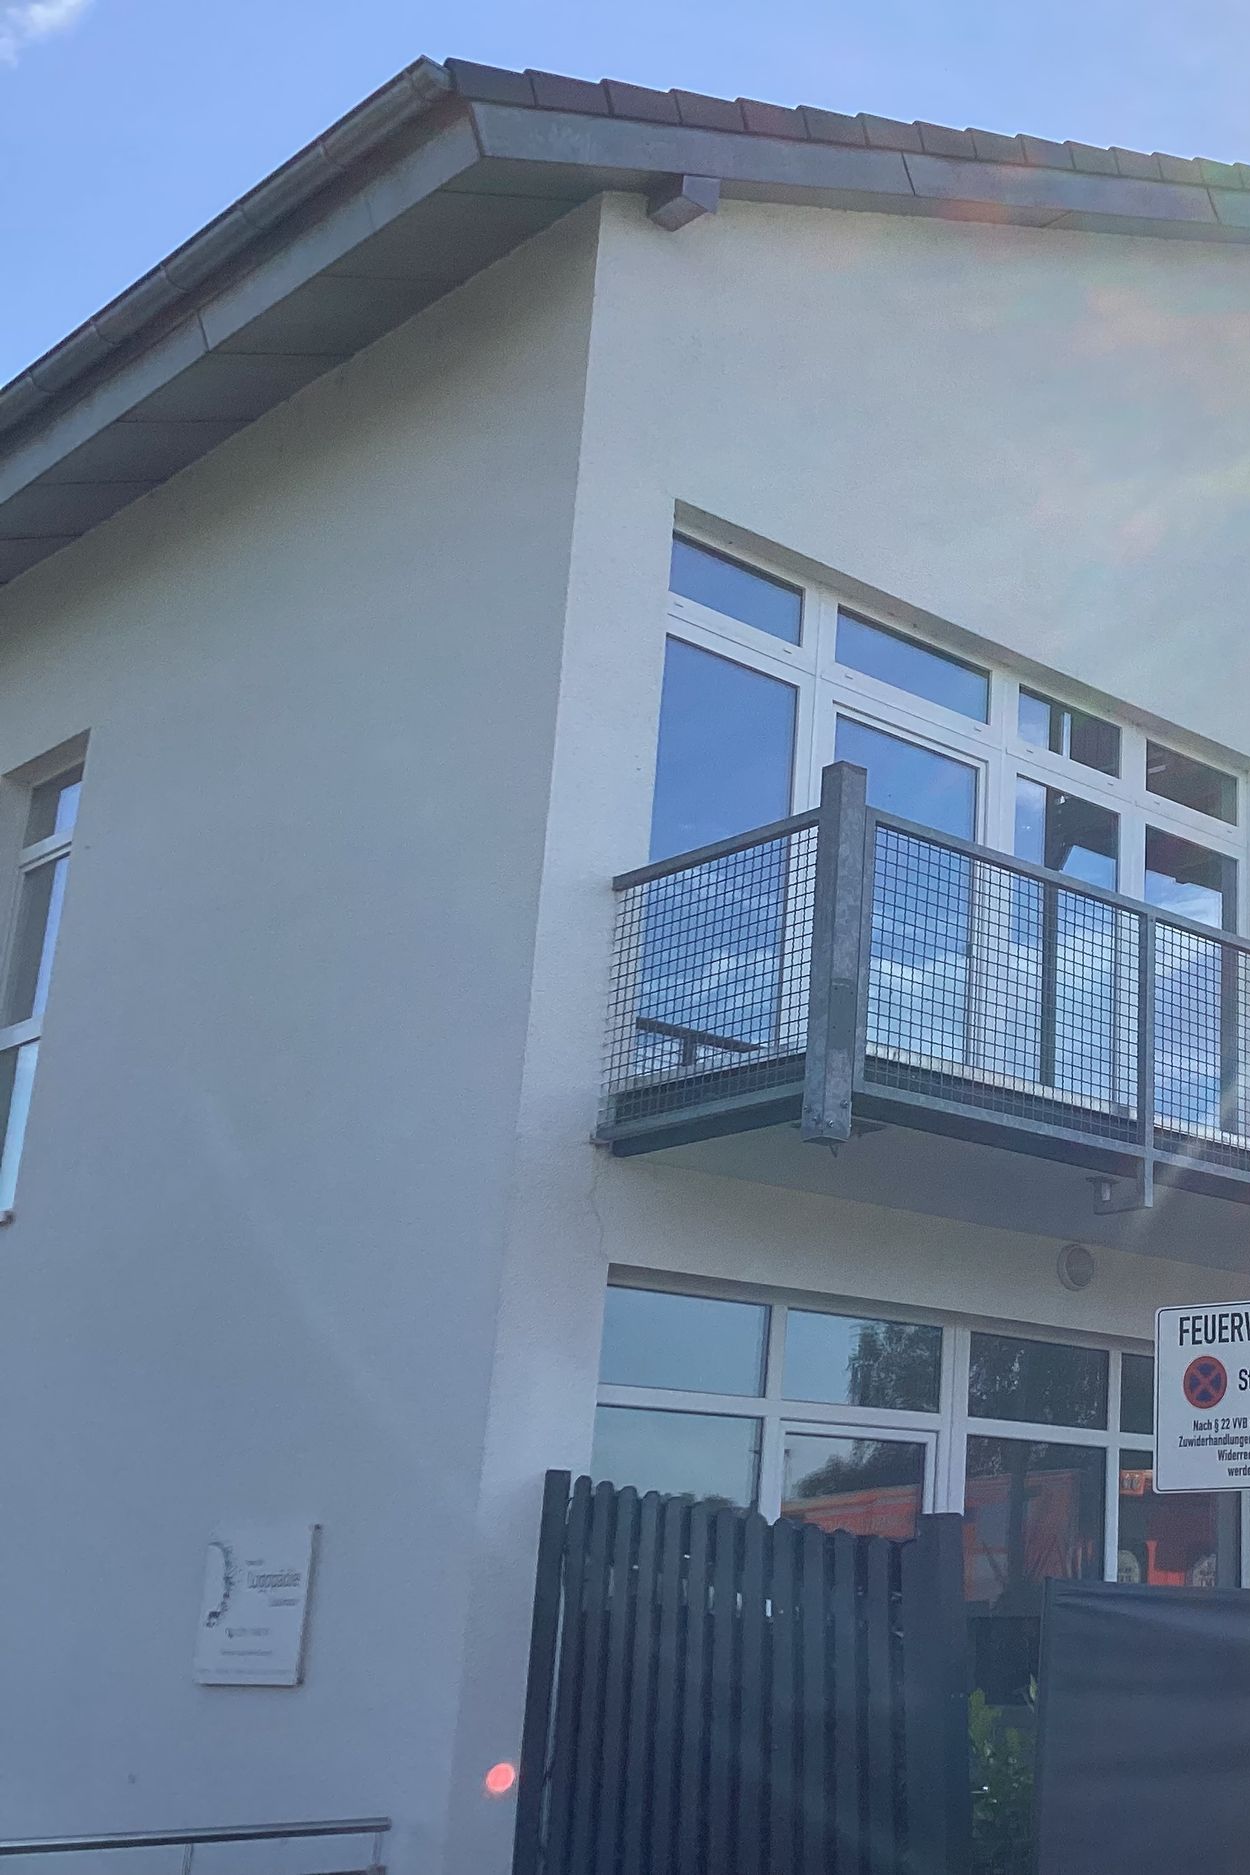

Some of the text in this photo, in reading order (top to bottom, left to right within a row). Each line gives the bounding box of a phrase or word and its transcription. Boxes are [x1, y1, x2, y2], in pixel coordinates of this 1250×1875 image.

[1193, 1420, 1212, 1431] Nach
[1214, 1420, 1219, 1433] §
[1221, 1419, 1230, 1429] 22
[1233, 1418, 1248, 1429] VVB
